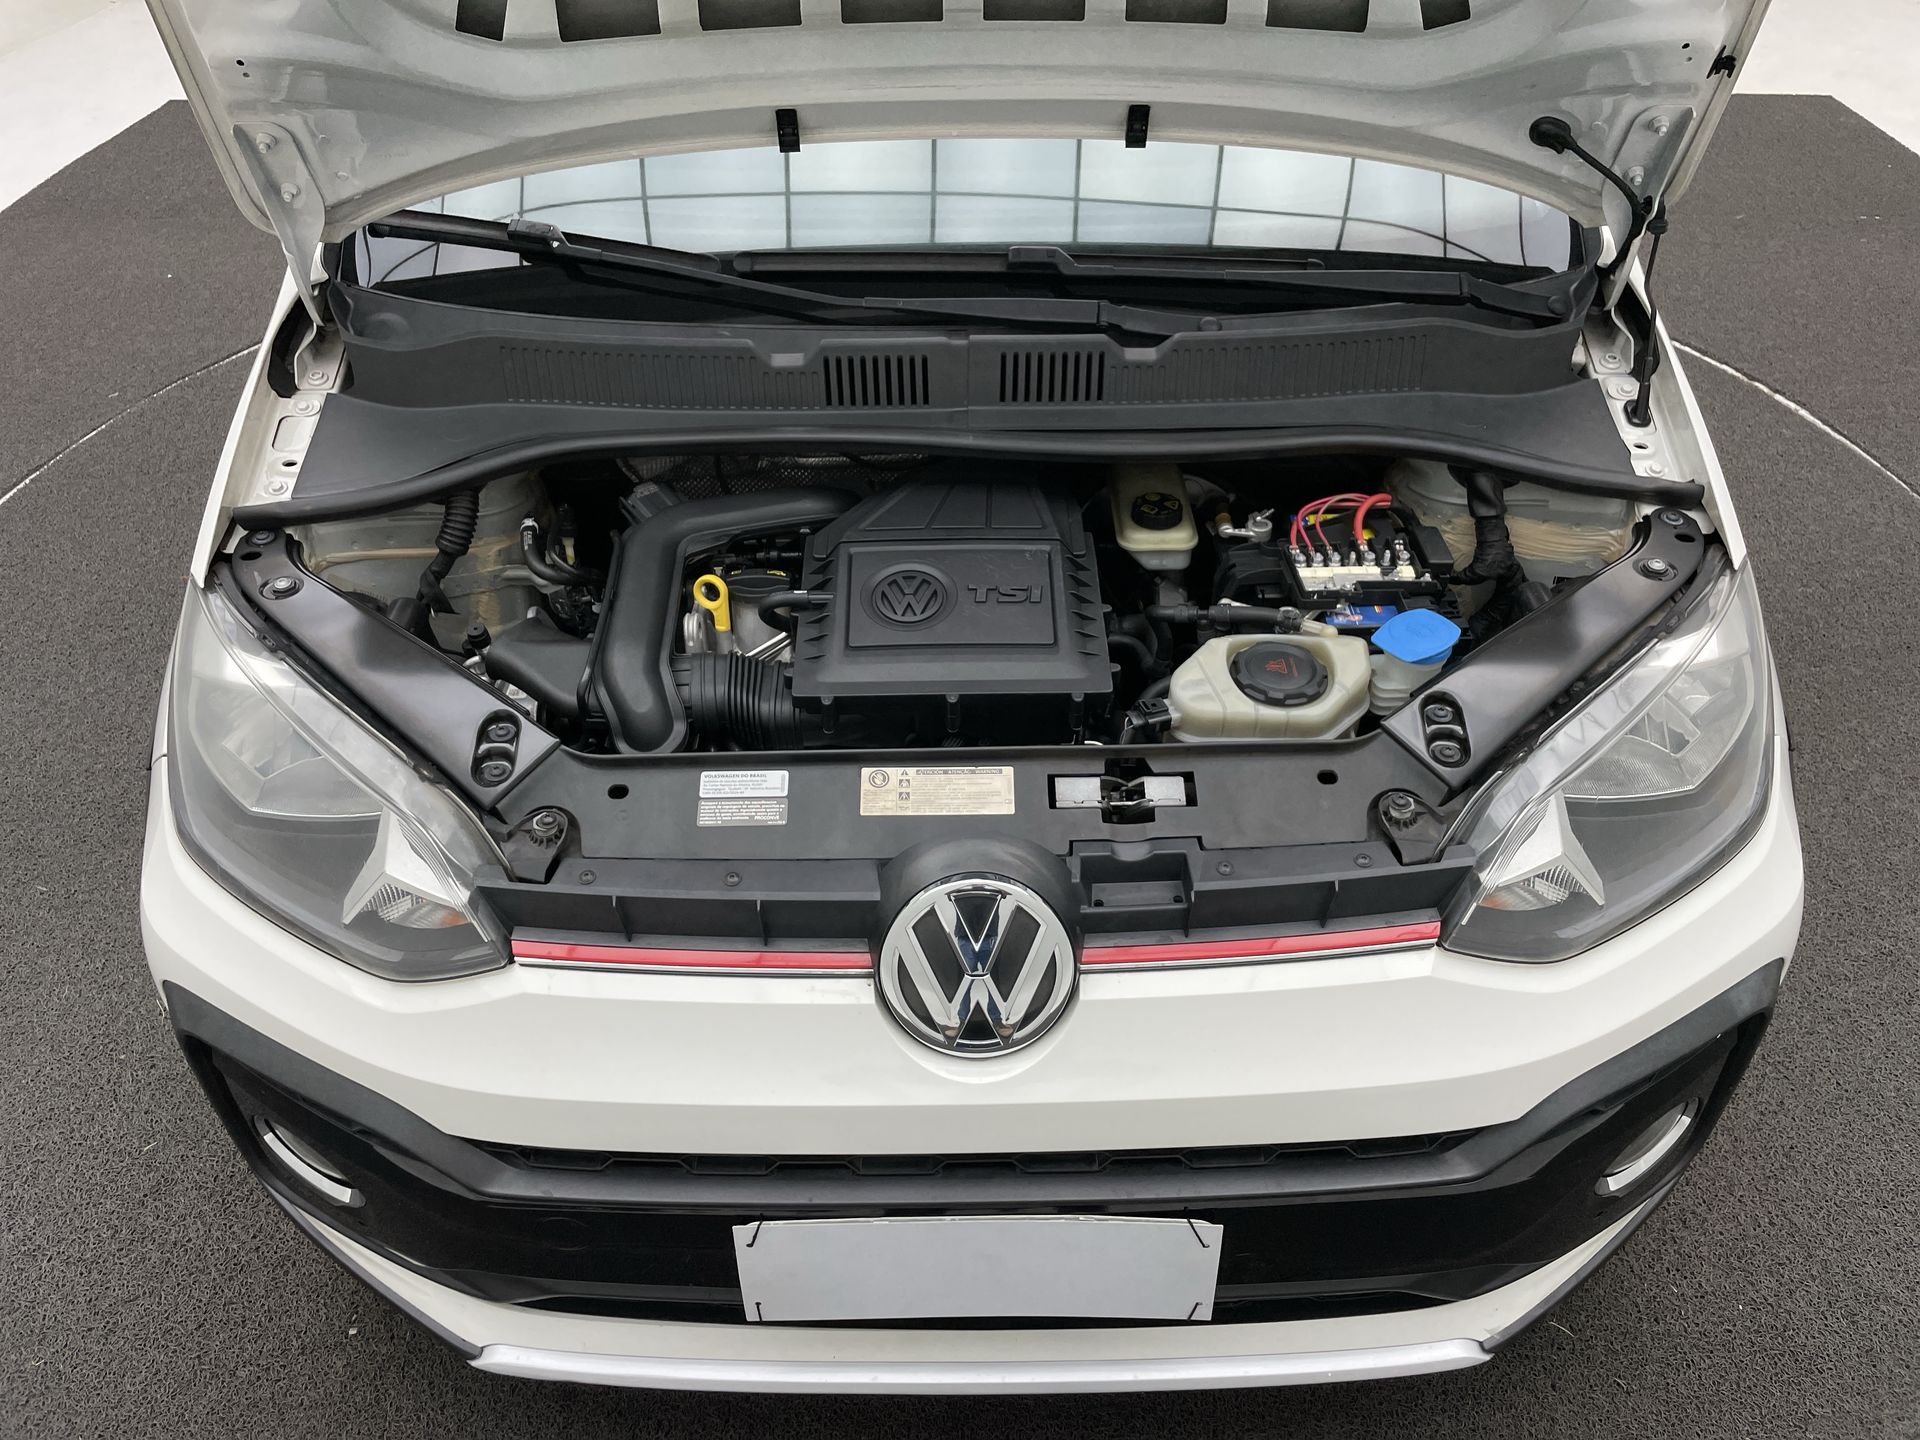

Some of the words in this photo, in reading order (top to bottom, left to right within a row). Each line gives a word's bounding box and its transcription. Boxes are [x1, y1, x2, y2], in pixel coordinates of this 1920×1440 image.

[873, 570, 947, 623] VW
[968, 584, 1043, 603] TSI
[879, 877, 1076, 1059] VW
